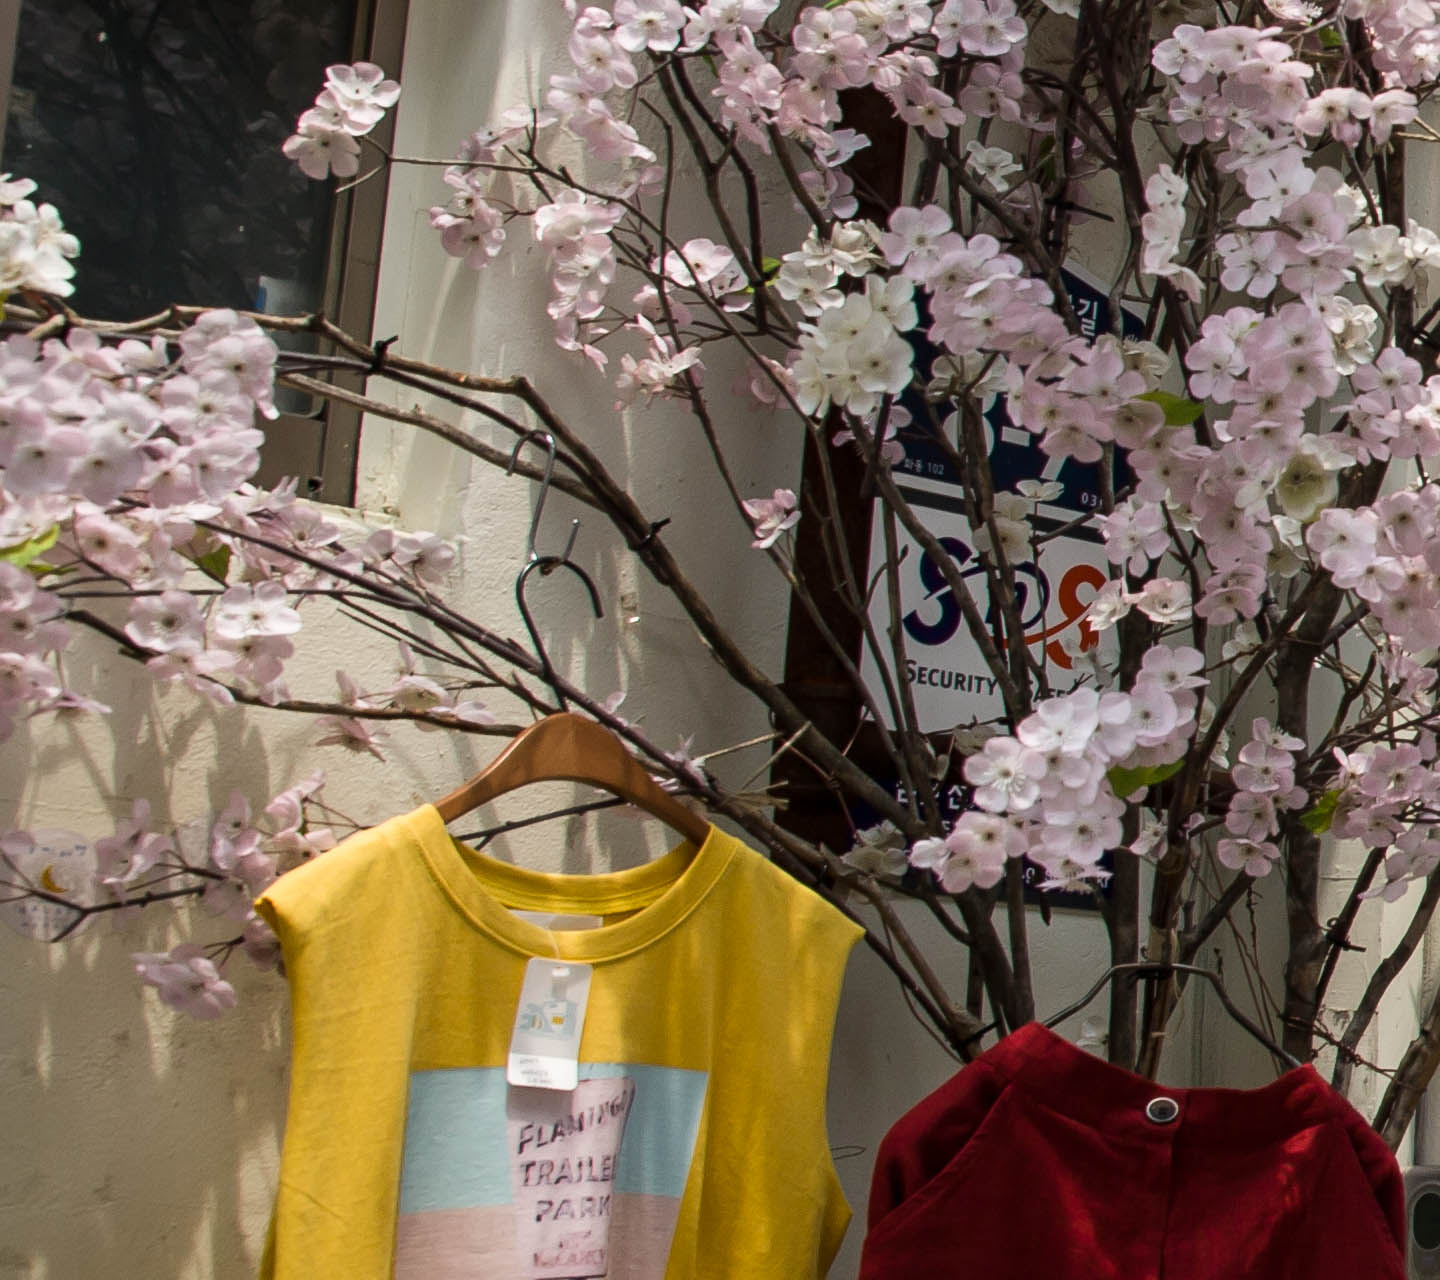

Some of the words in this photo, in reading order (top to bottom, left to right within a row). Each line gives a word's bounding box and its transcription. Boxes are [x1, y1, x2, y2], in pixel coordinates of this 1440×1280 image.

[927, 461, 945, 476] 102
[904, 659, 998, 696] SECURITY
[535, 1195, 612, 1223] PARK
